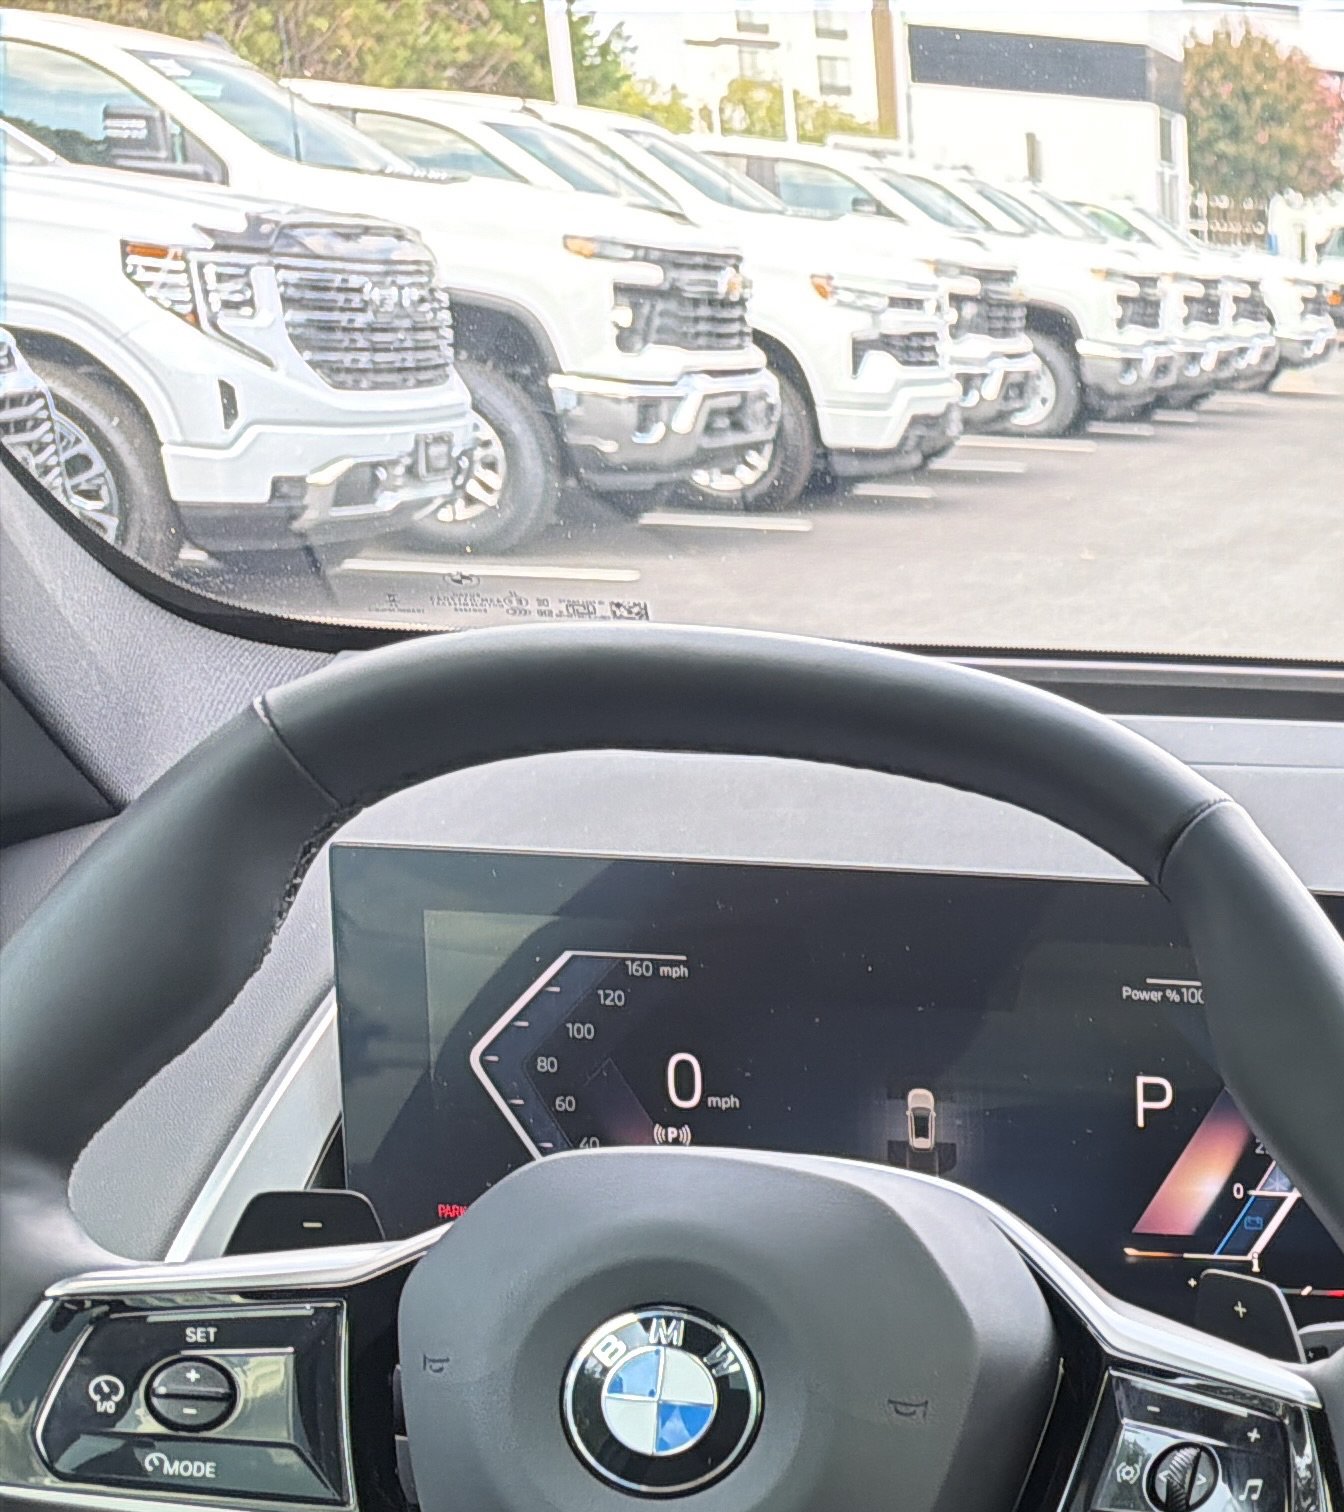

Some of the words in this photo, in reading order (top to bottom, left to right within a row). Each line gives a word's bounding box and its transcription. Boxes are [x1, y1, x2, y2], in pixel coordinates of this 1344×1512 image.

[625, 960, 653, 977] 160
[659, 964, 689, 980] mph
[597, 989, 625, 1006] 120
[1122, 985, 1163, 1002] Power
[565, 1022, 595, 1040] 100
[536, 1056, 558, 1073] 80
[667, 1052, 703, 1109] 0
[707, 1094, 740, 1111] mph
[555, 1095, 576, 1112] 60
[1136, 1075, 1173, 1128] P
[579, 1136, 600, 1148] 40
[185, 1326, 218, 1343] SET
[593, 1317, 741, 1378] BMW
[162, 1461, 217, 1478] MODE
